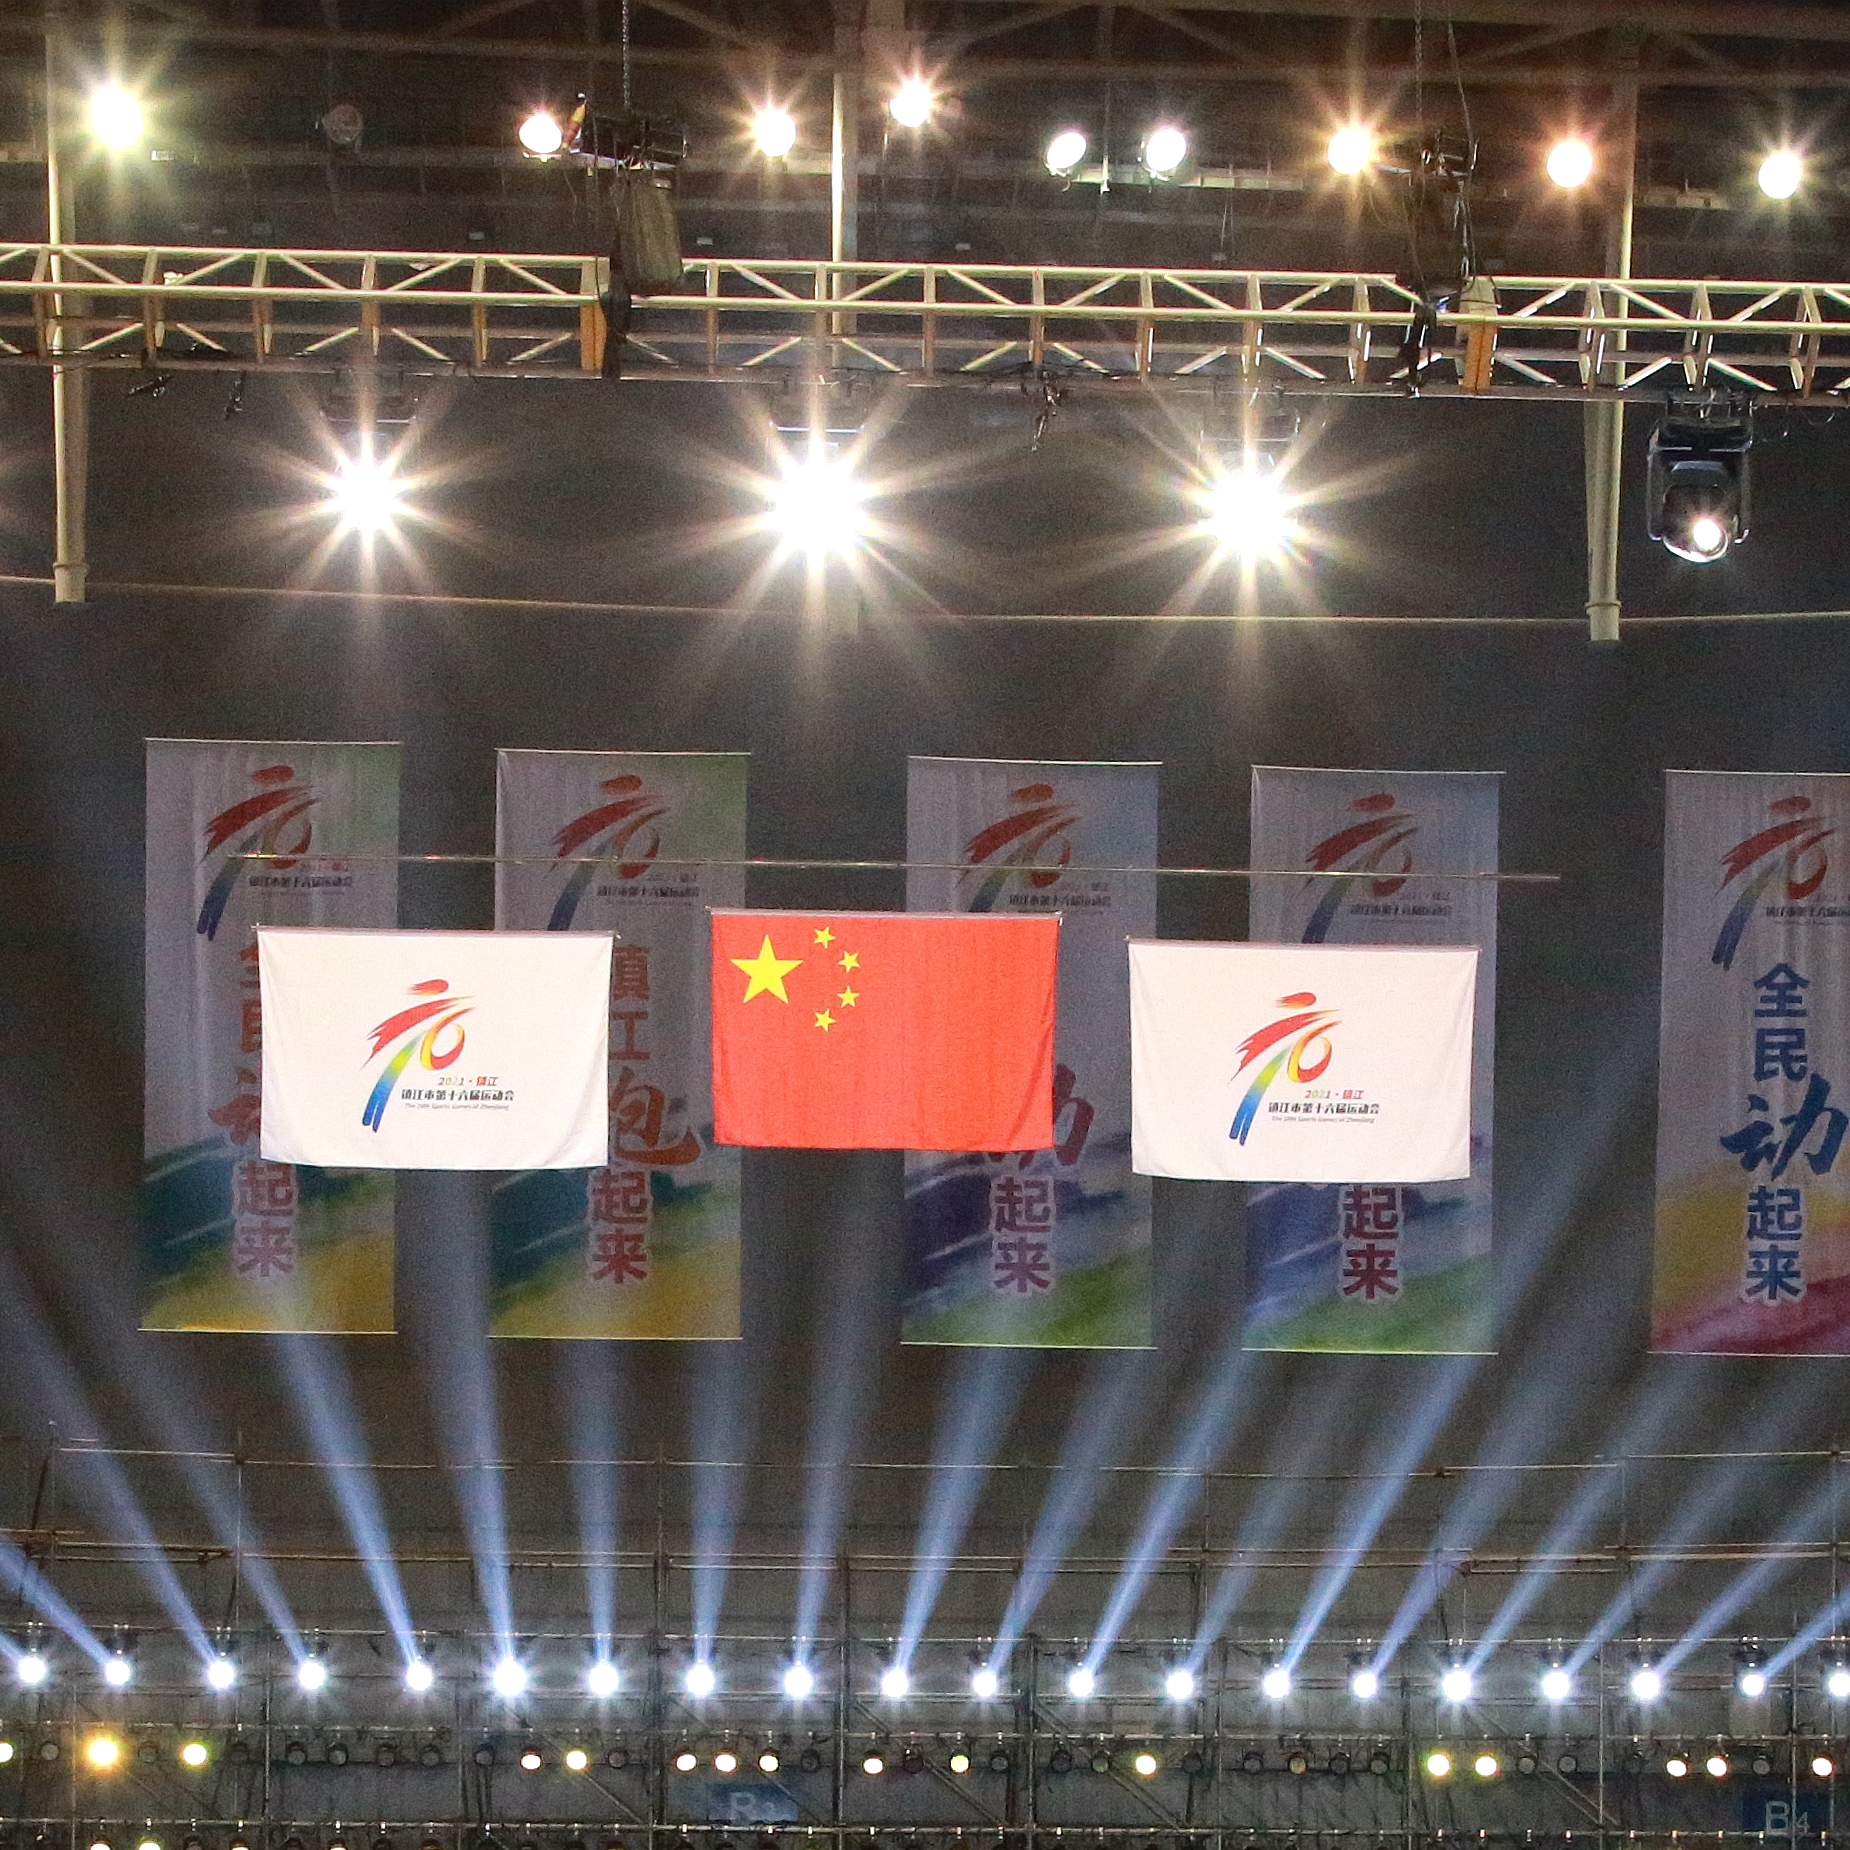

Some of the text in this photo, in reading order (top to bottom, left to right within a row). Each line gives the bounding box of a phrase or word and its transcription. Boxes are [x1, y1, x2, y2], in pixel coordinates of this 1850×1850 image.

[1721, 963, 1850, 1301] 全民动起来
